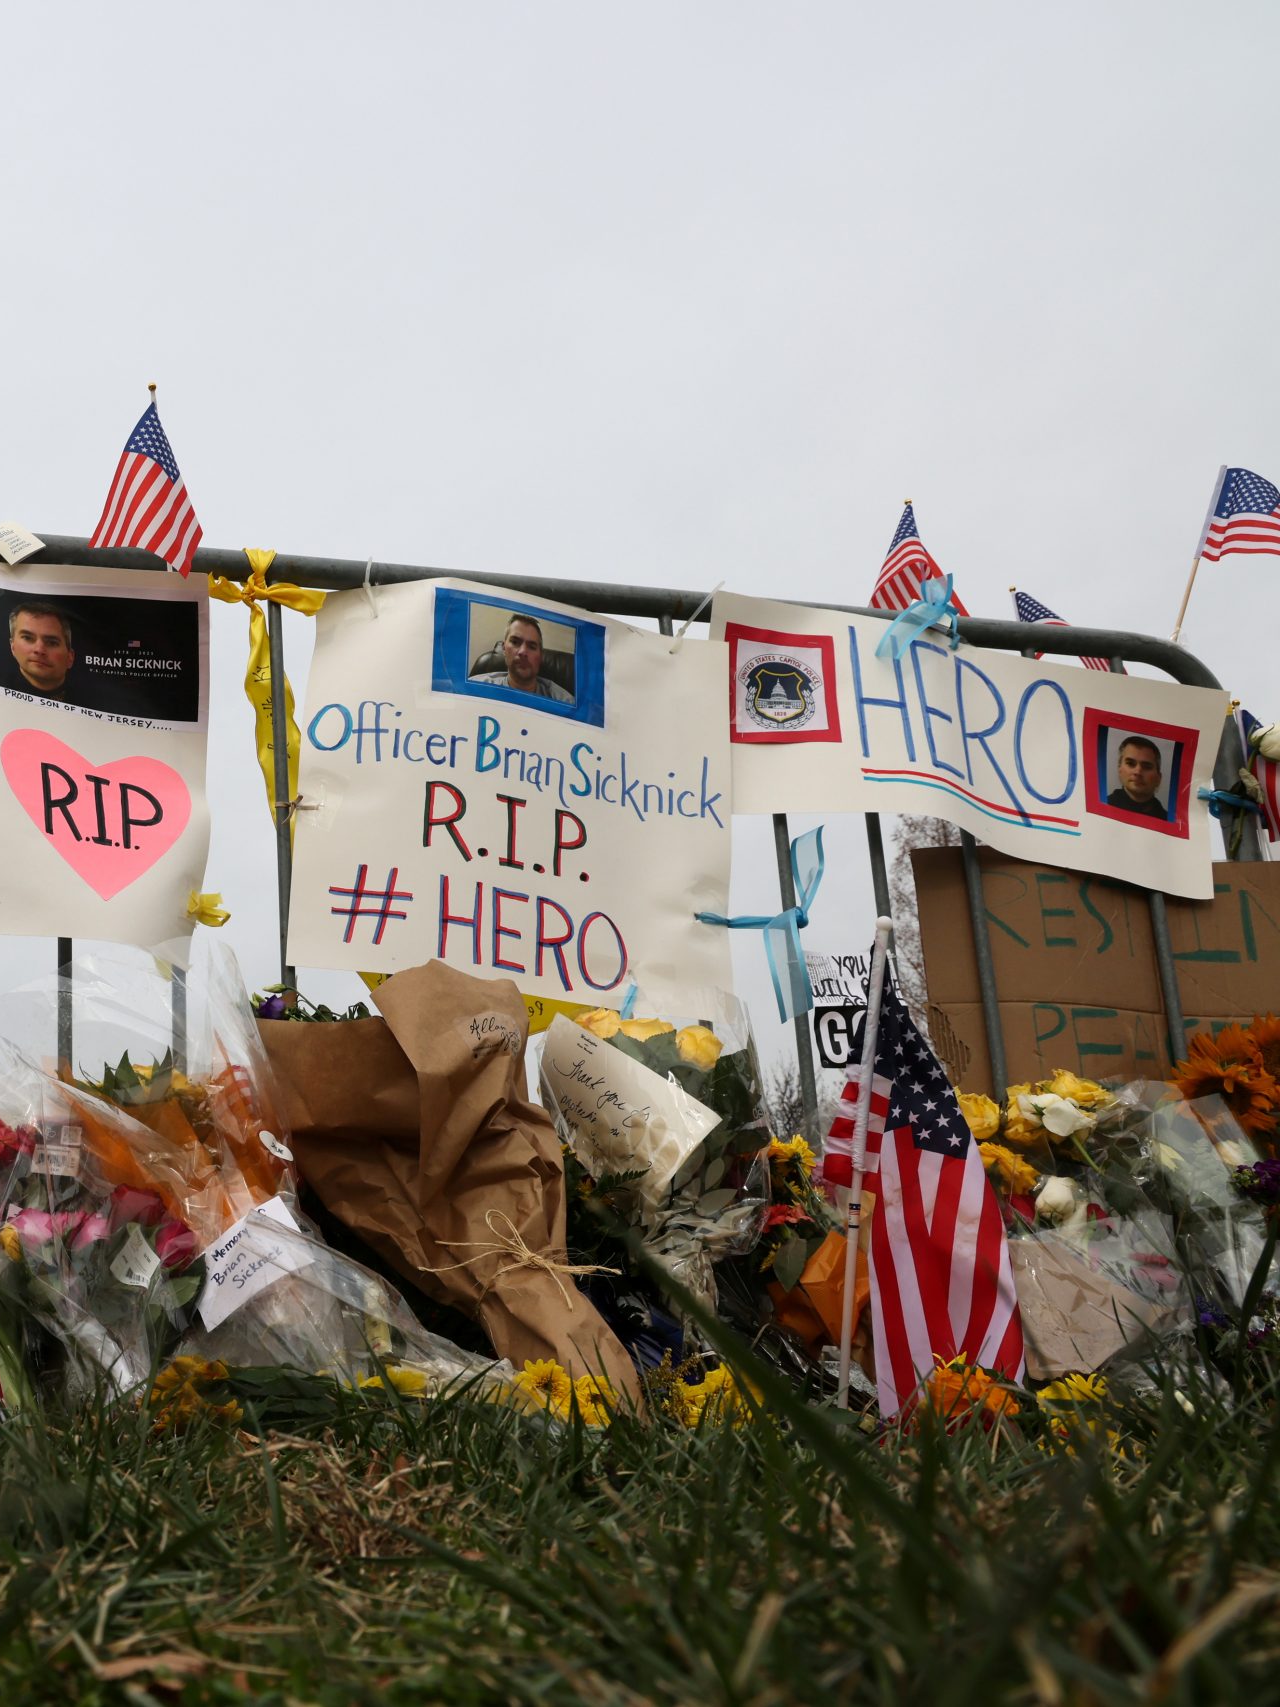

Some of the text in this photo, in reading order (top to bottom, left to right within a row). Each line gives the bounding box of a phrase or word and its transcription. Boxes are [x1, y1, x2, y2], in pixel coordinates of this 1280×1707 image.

[85, 655, 182, 670] BRIAN SICKNICK
[740, 655, 820, 685] UNITED STATES CAPITOL POLICE
[4, 688, 33, 702] PROUD
[40, 698, 59, 709] SON
[81, 708, 103, 719] NEW
[847, 624, 1078, 829] HERO
[307, 700, 725, 829] Officer Brian Sicknick
[40, 762, 164, 851] R.I.P.
[422, 780, 590, 883] R.I.P.
[831, 955, 868, 978] YOU
[553, 1060, 606, 1090] Thank
[211, 1227, 252, 1262] Memory
[210, 1251, 247, 1287] Brian
